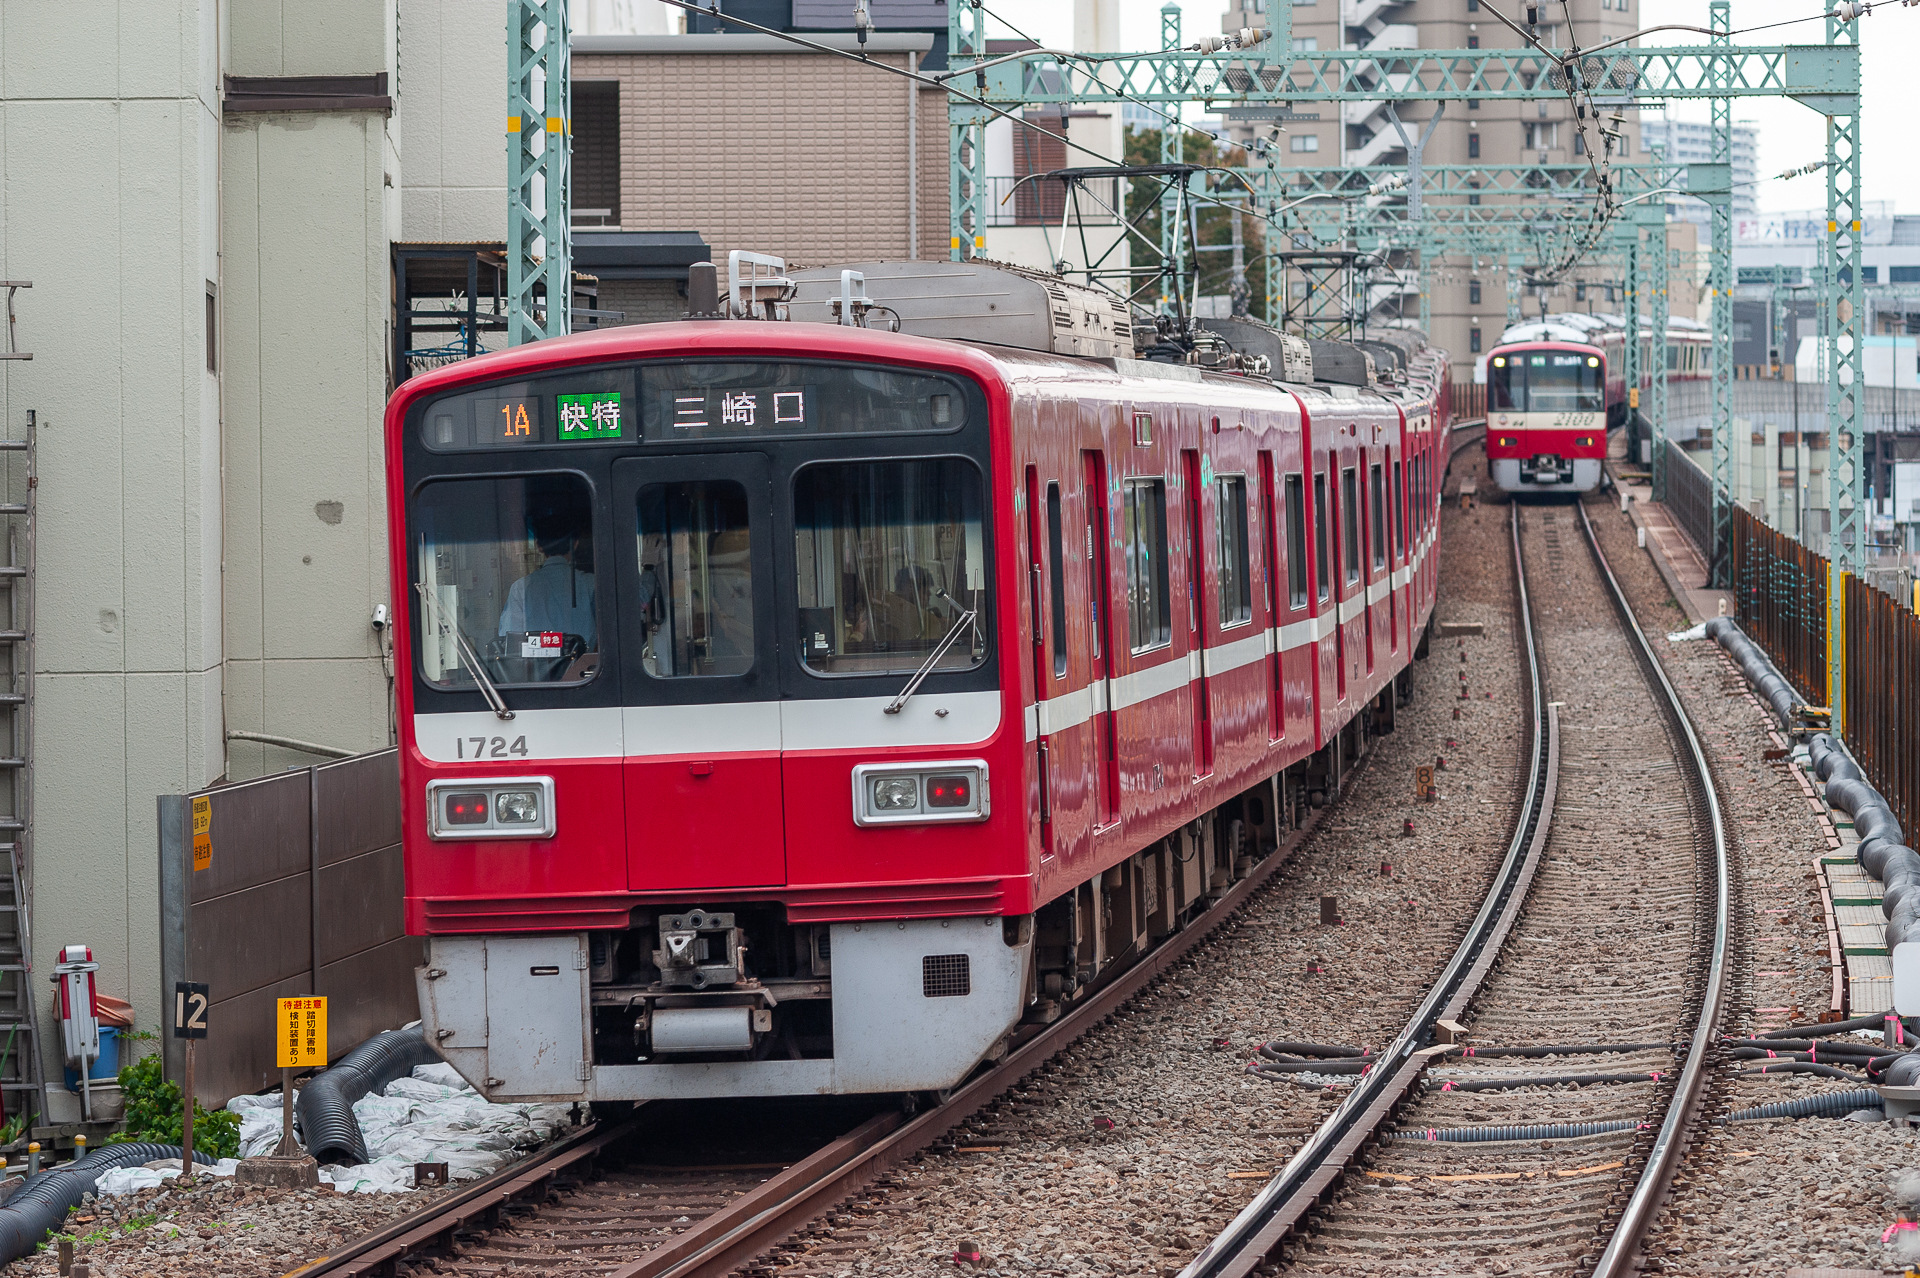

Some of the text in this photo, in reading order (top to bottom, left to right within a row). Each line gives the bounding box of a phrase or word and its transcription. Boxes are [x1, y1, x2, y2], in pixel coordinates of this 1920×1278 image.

[501, 403, 531, 437] 1A
[559, 400, 621, 432] 快特
[673, 391, 804, 427] 三崎口
[1553, 412, 1596, 427] 2100
[543, 635, 560, 645] 特急
[457, 735, 529, 759] 1724
[176, 992, 207, 1029] 12
[283, 999, 322, 1010] 待避注意
[289, 1012, 299, 1065] 検知装置あり
[306, 1011, 316, 1055] 踏切障害物
